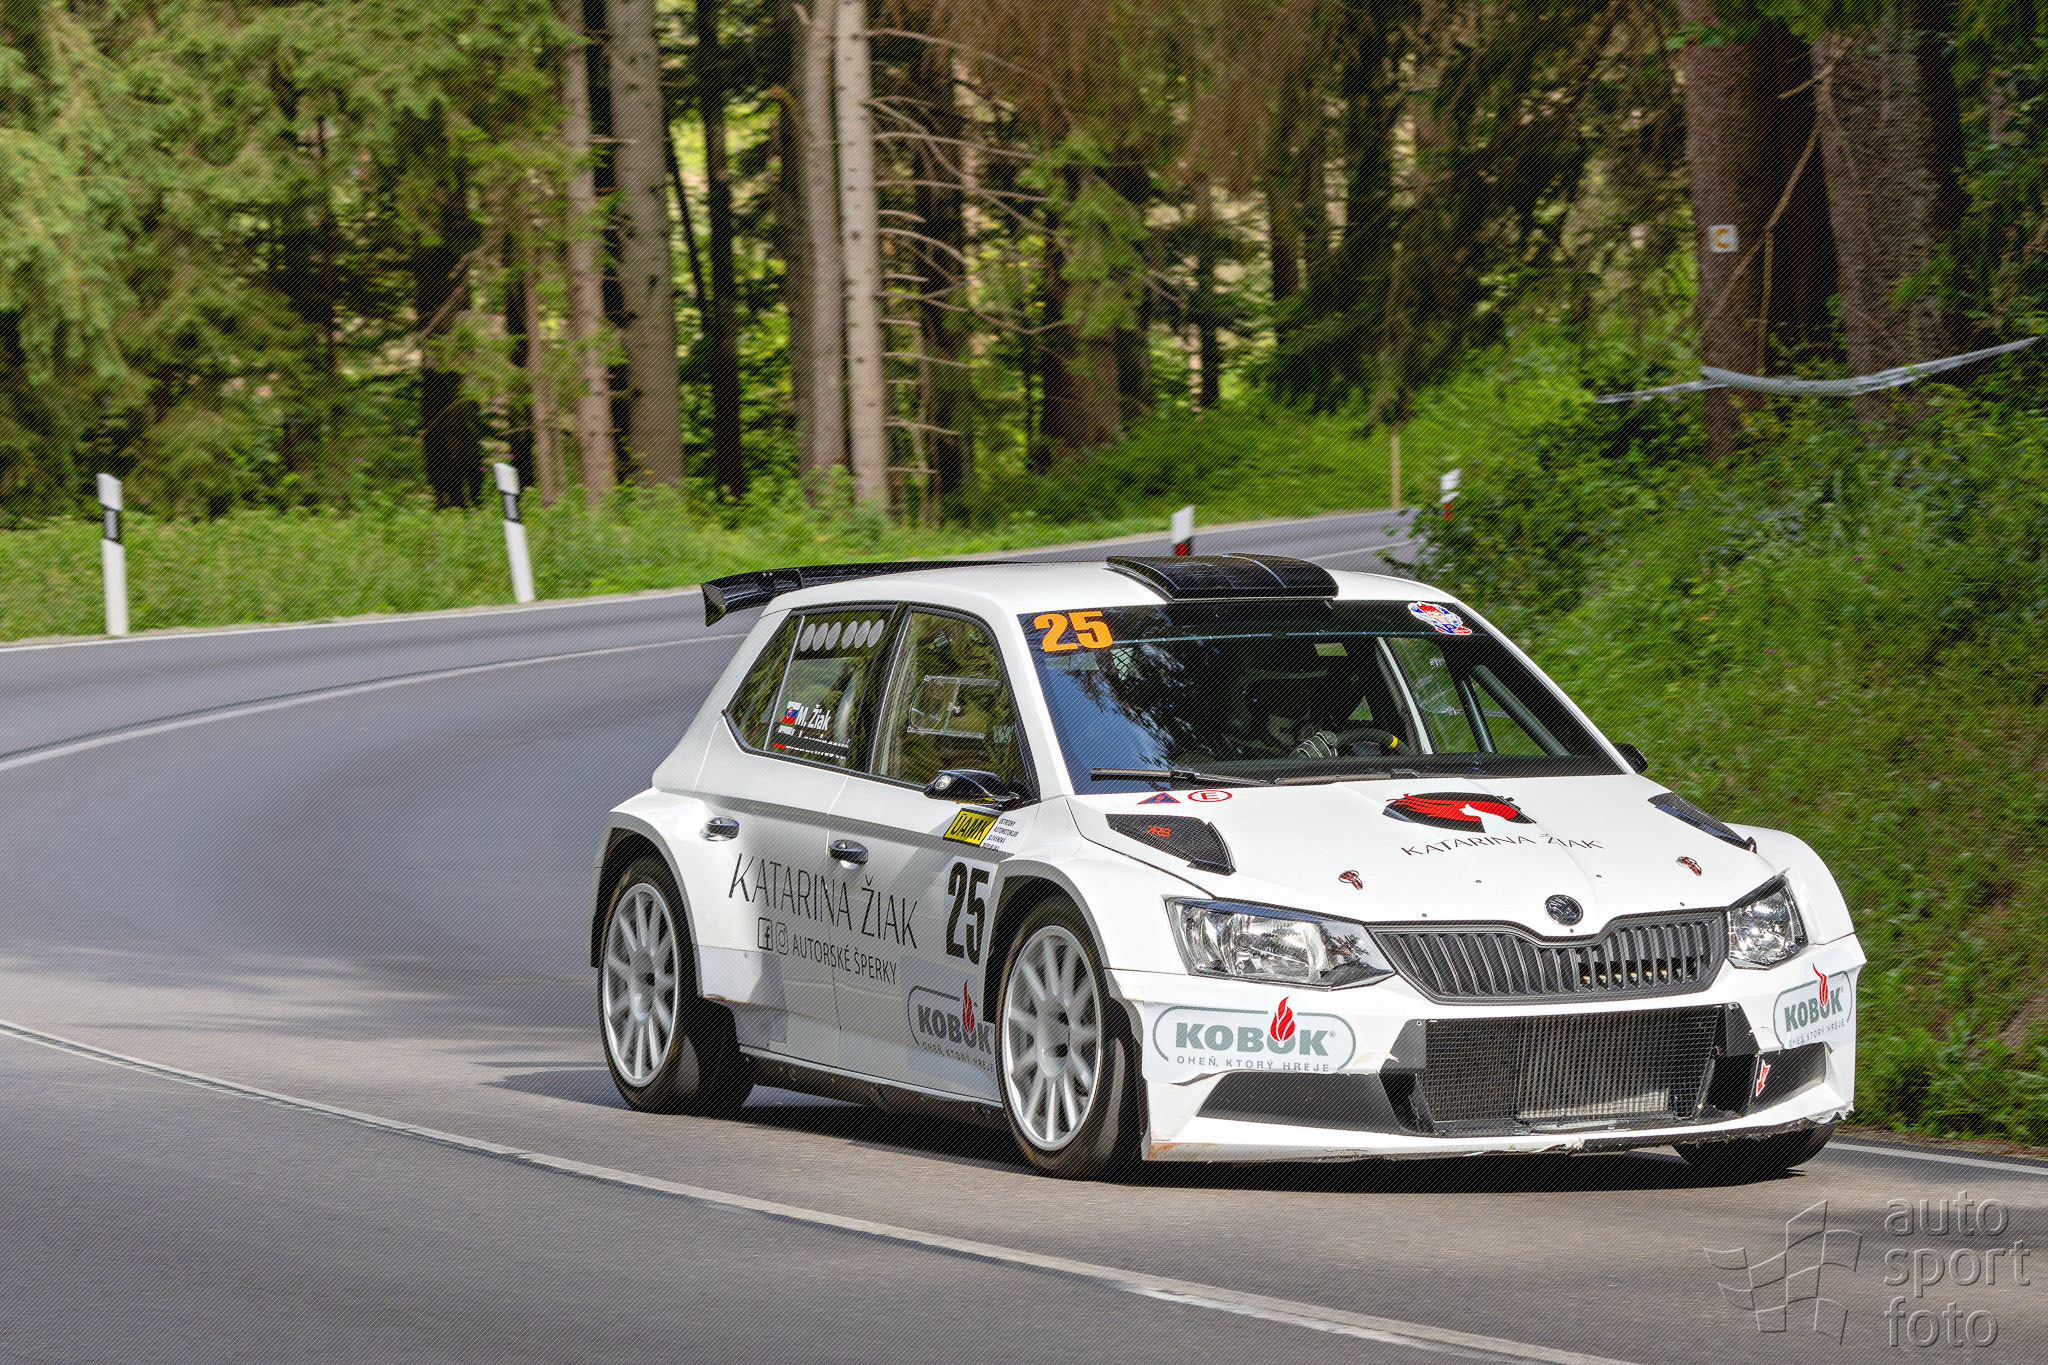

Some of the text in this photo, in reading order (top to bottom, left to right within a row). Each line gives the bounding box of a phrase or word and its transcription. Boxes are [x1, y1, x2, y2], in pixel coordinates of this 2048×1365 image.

[1033, 610, 1113, 653] 25
[807, 703, 831, 731] Žiak
[1400, 833, 1604, 856] KATARINA ŽIAK
[728, 853, 918, 949] KATARINA ŽIAK
[945, 861, 990, 965] 25
[792, 934, 897, 984] AUTORSKÉ ŠPERKY
[1225, 1059, 1274, 1071] KTORÝ
[1283, 1062, 1330, 1073] HREJE
